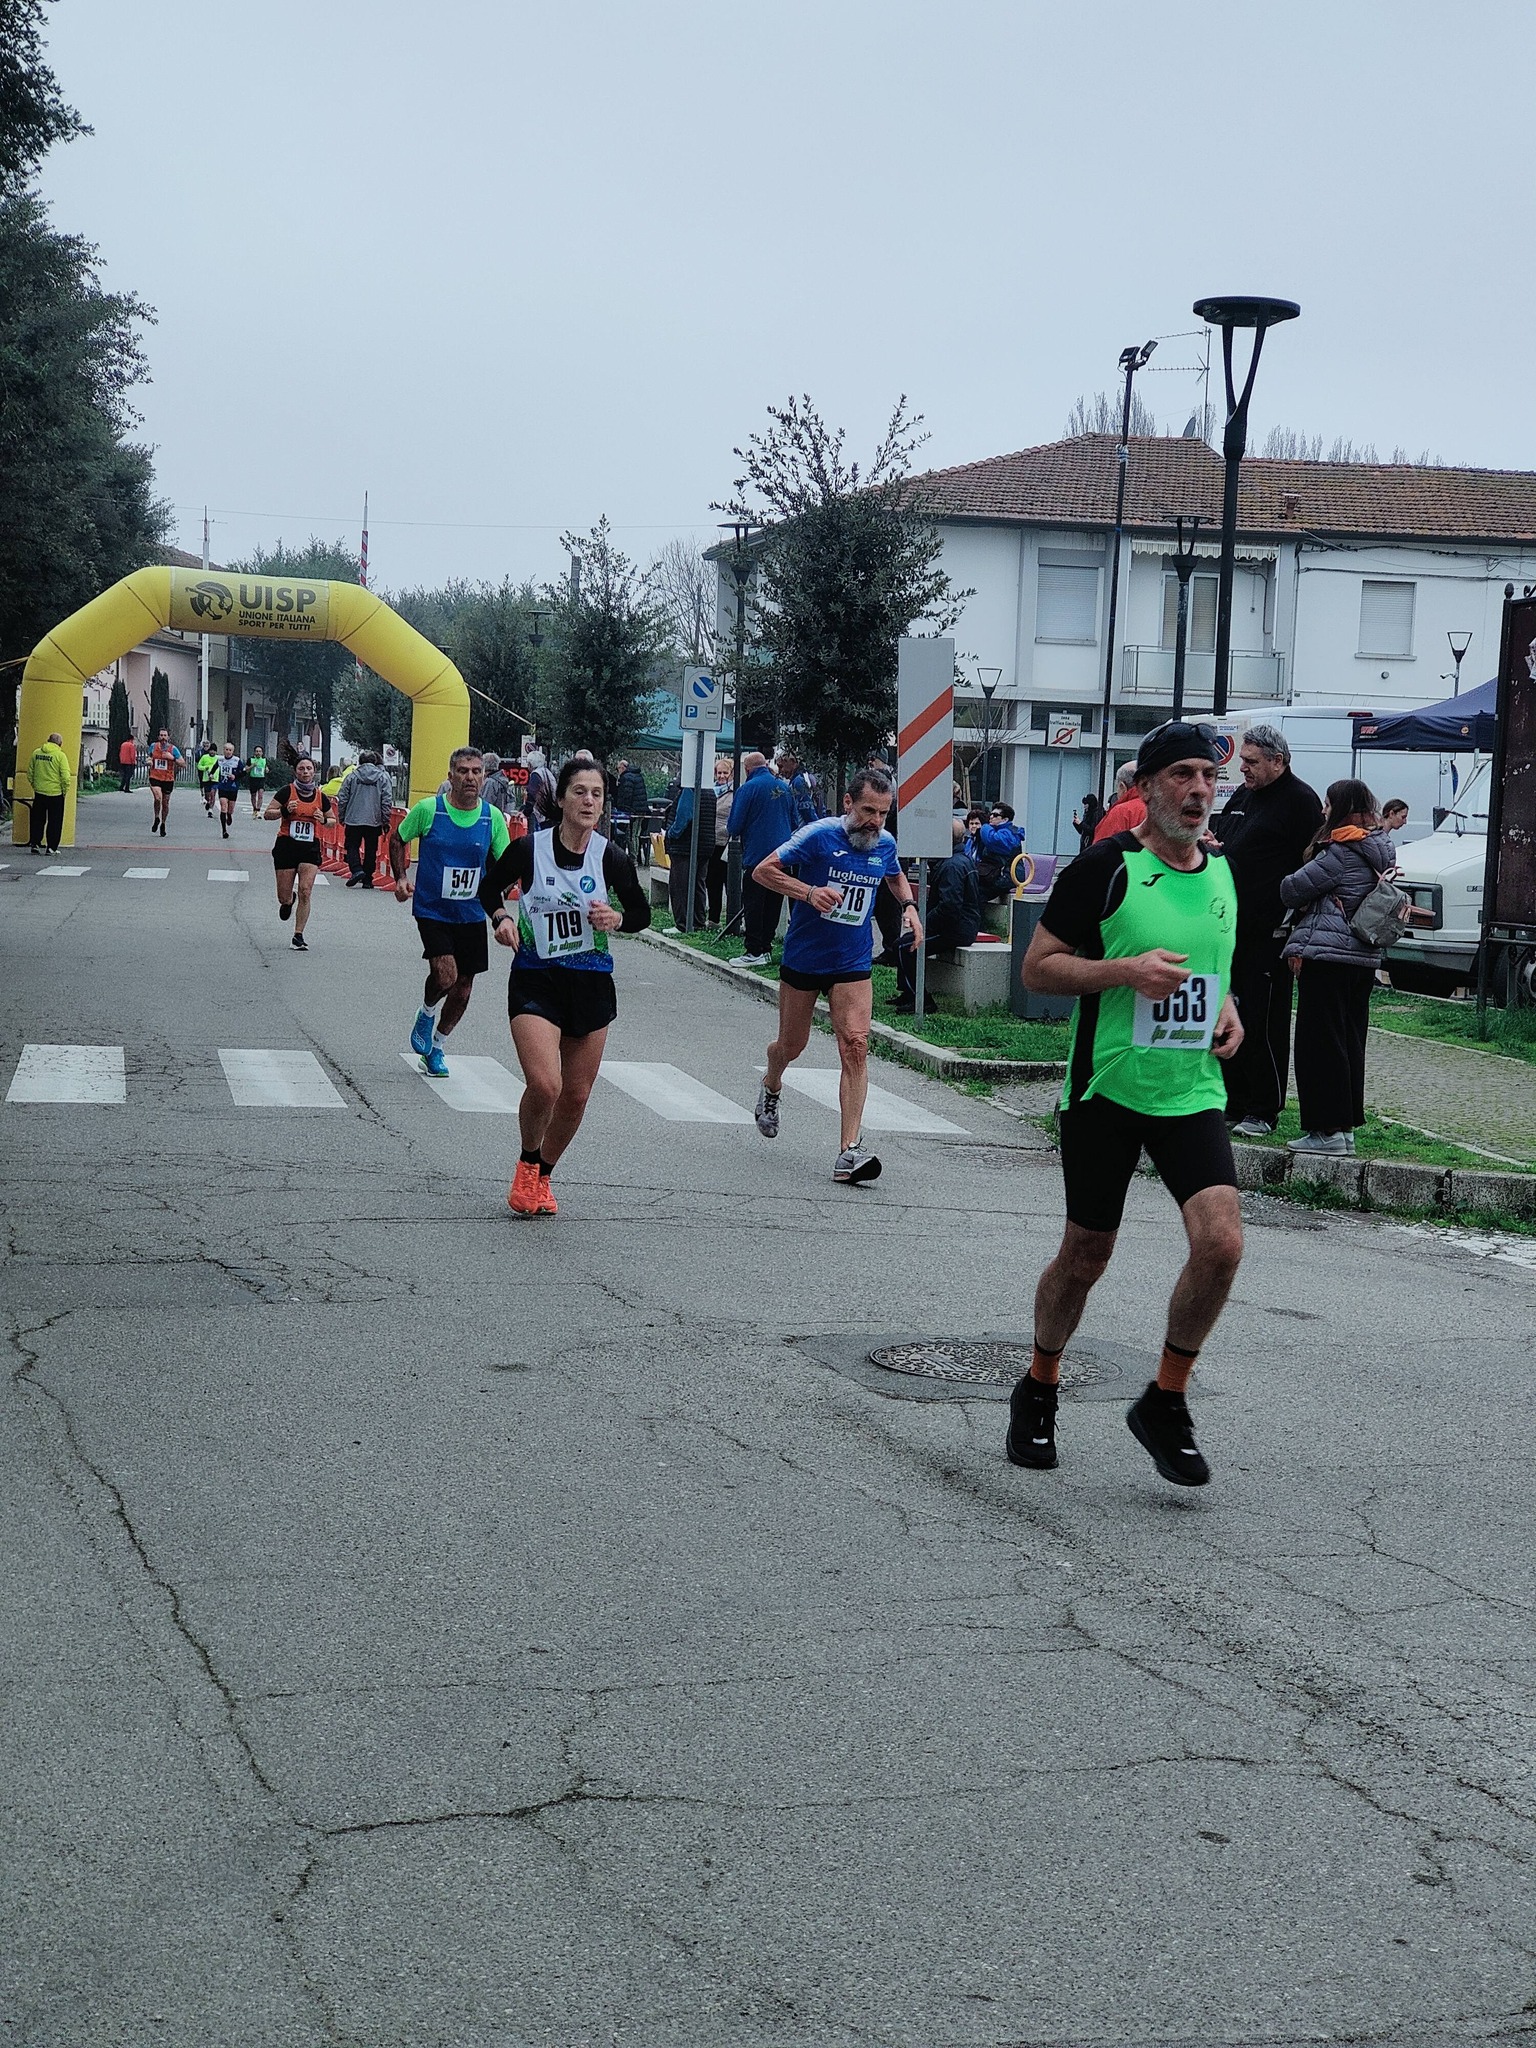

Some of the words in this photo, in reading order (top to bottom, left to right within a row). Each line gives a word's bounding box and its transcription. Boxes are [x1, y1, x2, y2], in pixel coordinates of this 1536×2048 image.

[239, 583, 316, 613] UISP
[238, 610, 273, 621] UNIONE
[276, 613, 316, 624] ITALIANA
[238, 618, 266, 629] SPORT
[269, 621, 285, 630] PER
[288, 622, 311, 631] TUTTI
[687, 706, 696, 716] P
[294, 821, 311, 835] 678
[451, 868, 476, 889] 547
[837, 885, 866, 912] 718
[544, 910, 583, 942] 709
